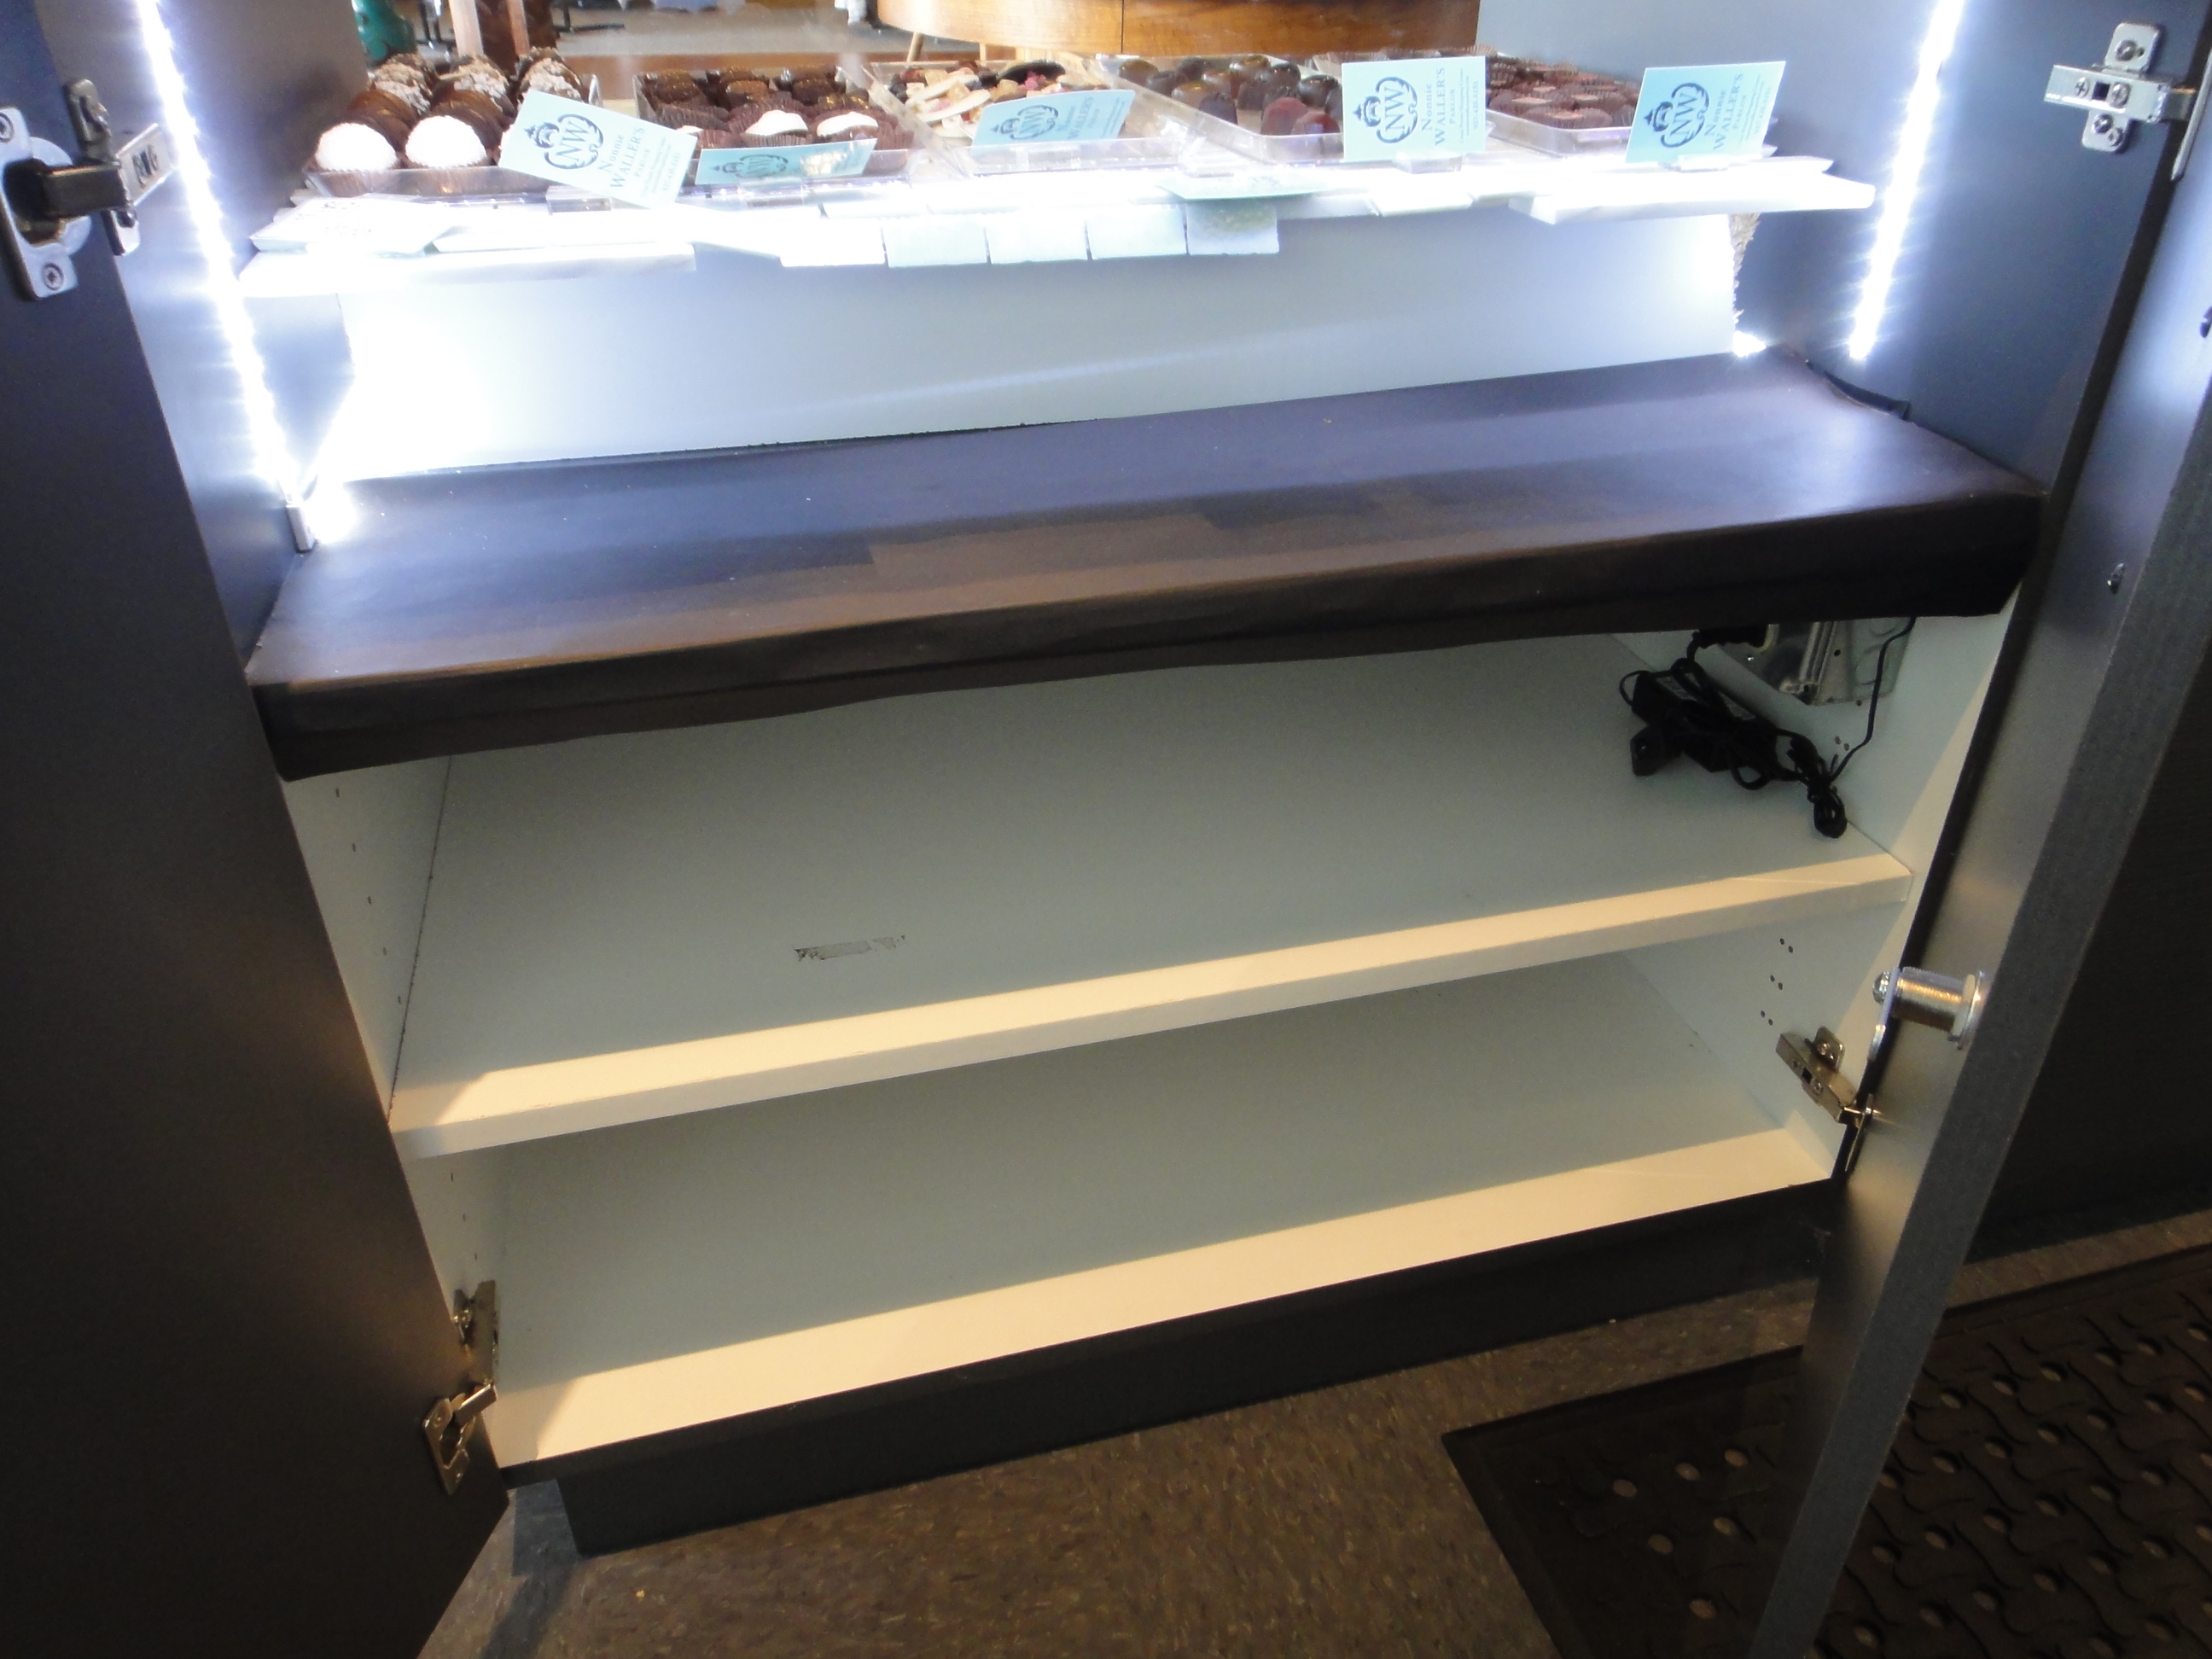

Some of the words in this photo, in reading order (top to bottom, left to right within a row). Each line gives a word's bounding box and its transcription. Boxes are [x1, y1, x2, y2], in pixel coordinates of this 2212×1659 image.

[1421, 83, 1434, 131] Nonnie
[1435, 67, 1447, 146] WALLER'S
[1704, 89, 1727, 137] Nonnie
[1713, 73, 1743, 150] WALLER'S
[599, 133, 625, 172] Nonnie
[610, 127, 645, 189] WALLER'S
